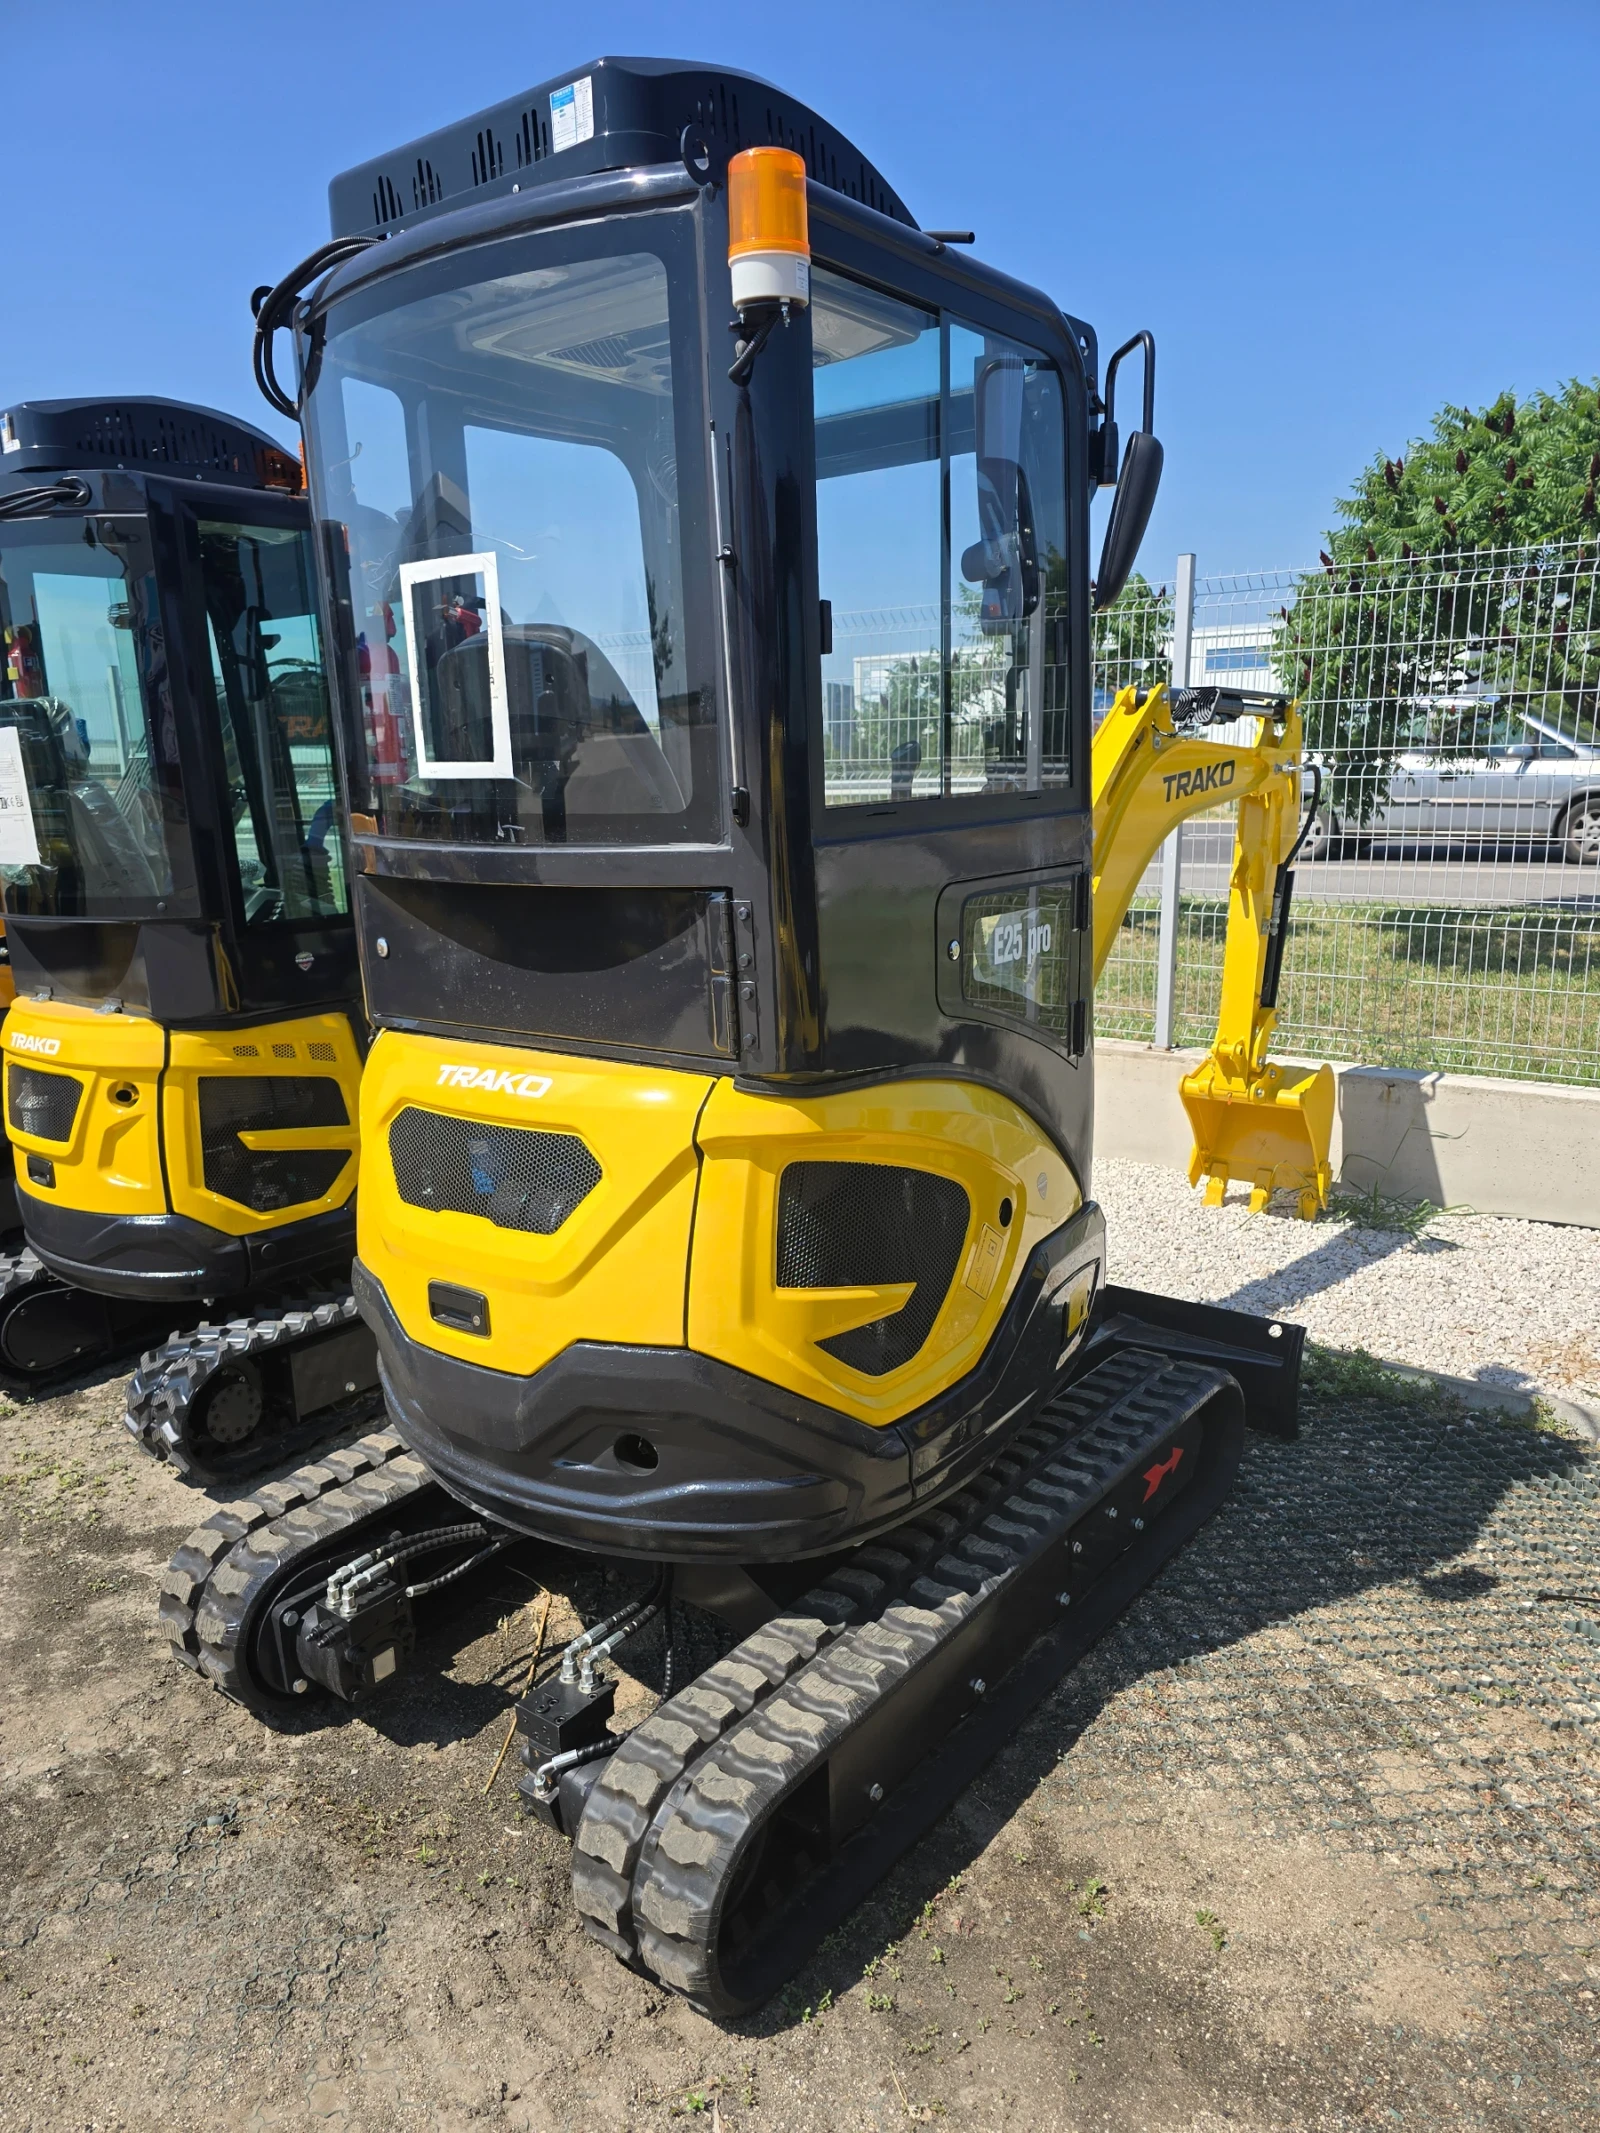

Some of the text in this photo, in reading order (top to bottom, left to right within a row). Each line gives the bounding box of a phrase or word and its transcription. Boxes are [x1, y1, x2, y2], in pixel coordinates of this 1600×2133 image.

[1163, 759, 1236, 803] TRAKO
[994, 922, 1052, 965] E25 pro
[10, 1031, 61, 1056] TRAKO
[436, 1064, 554, 1098] TRAKO
